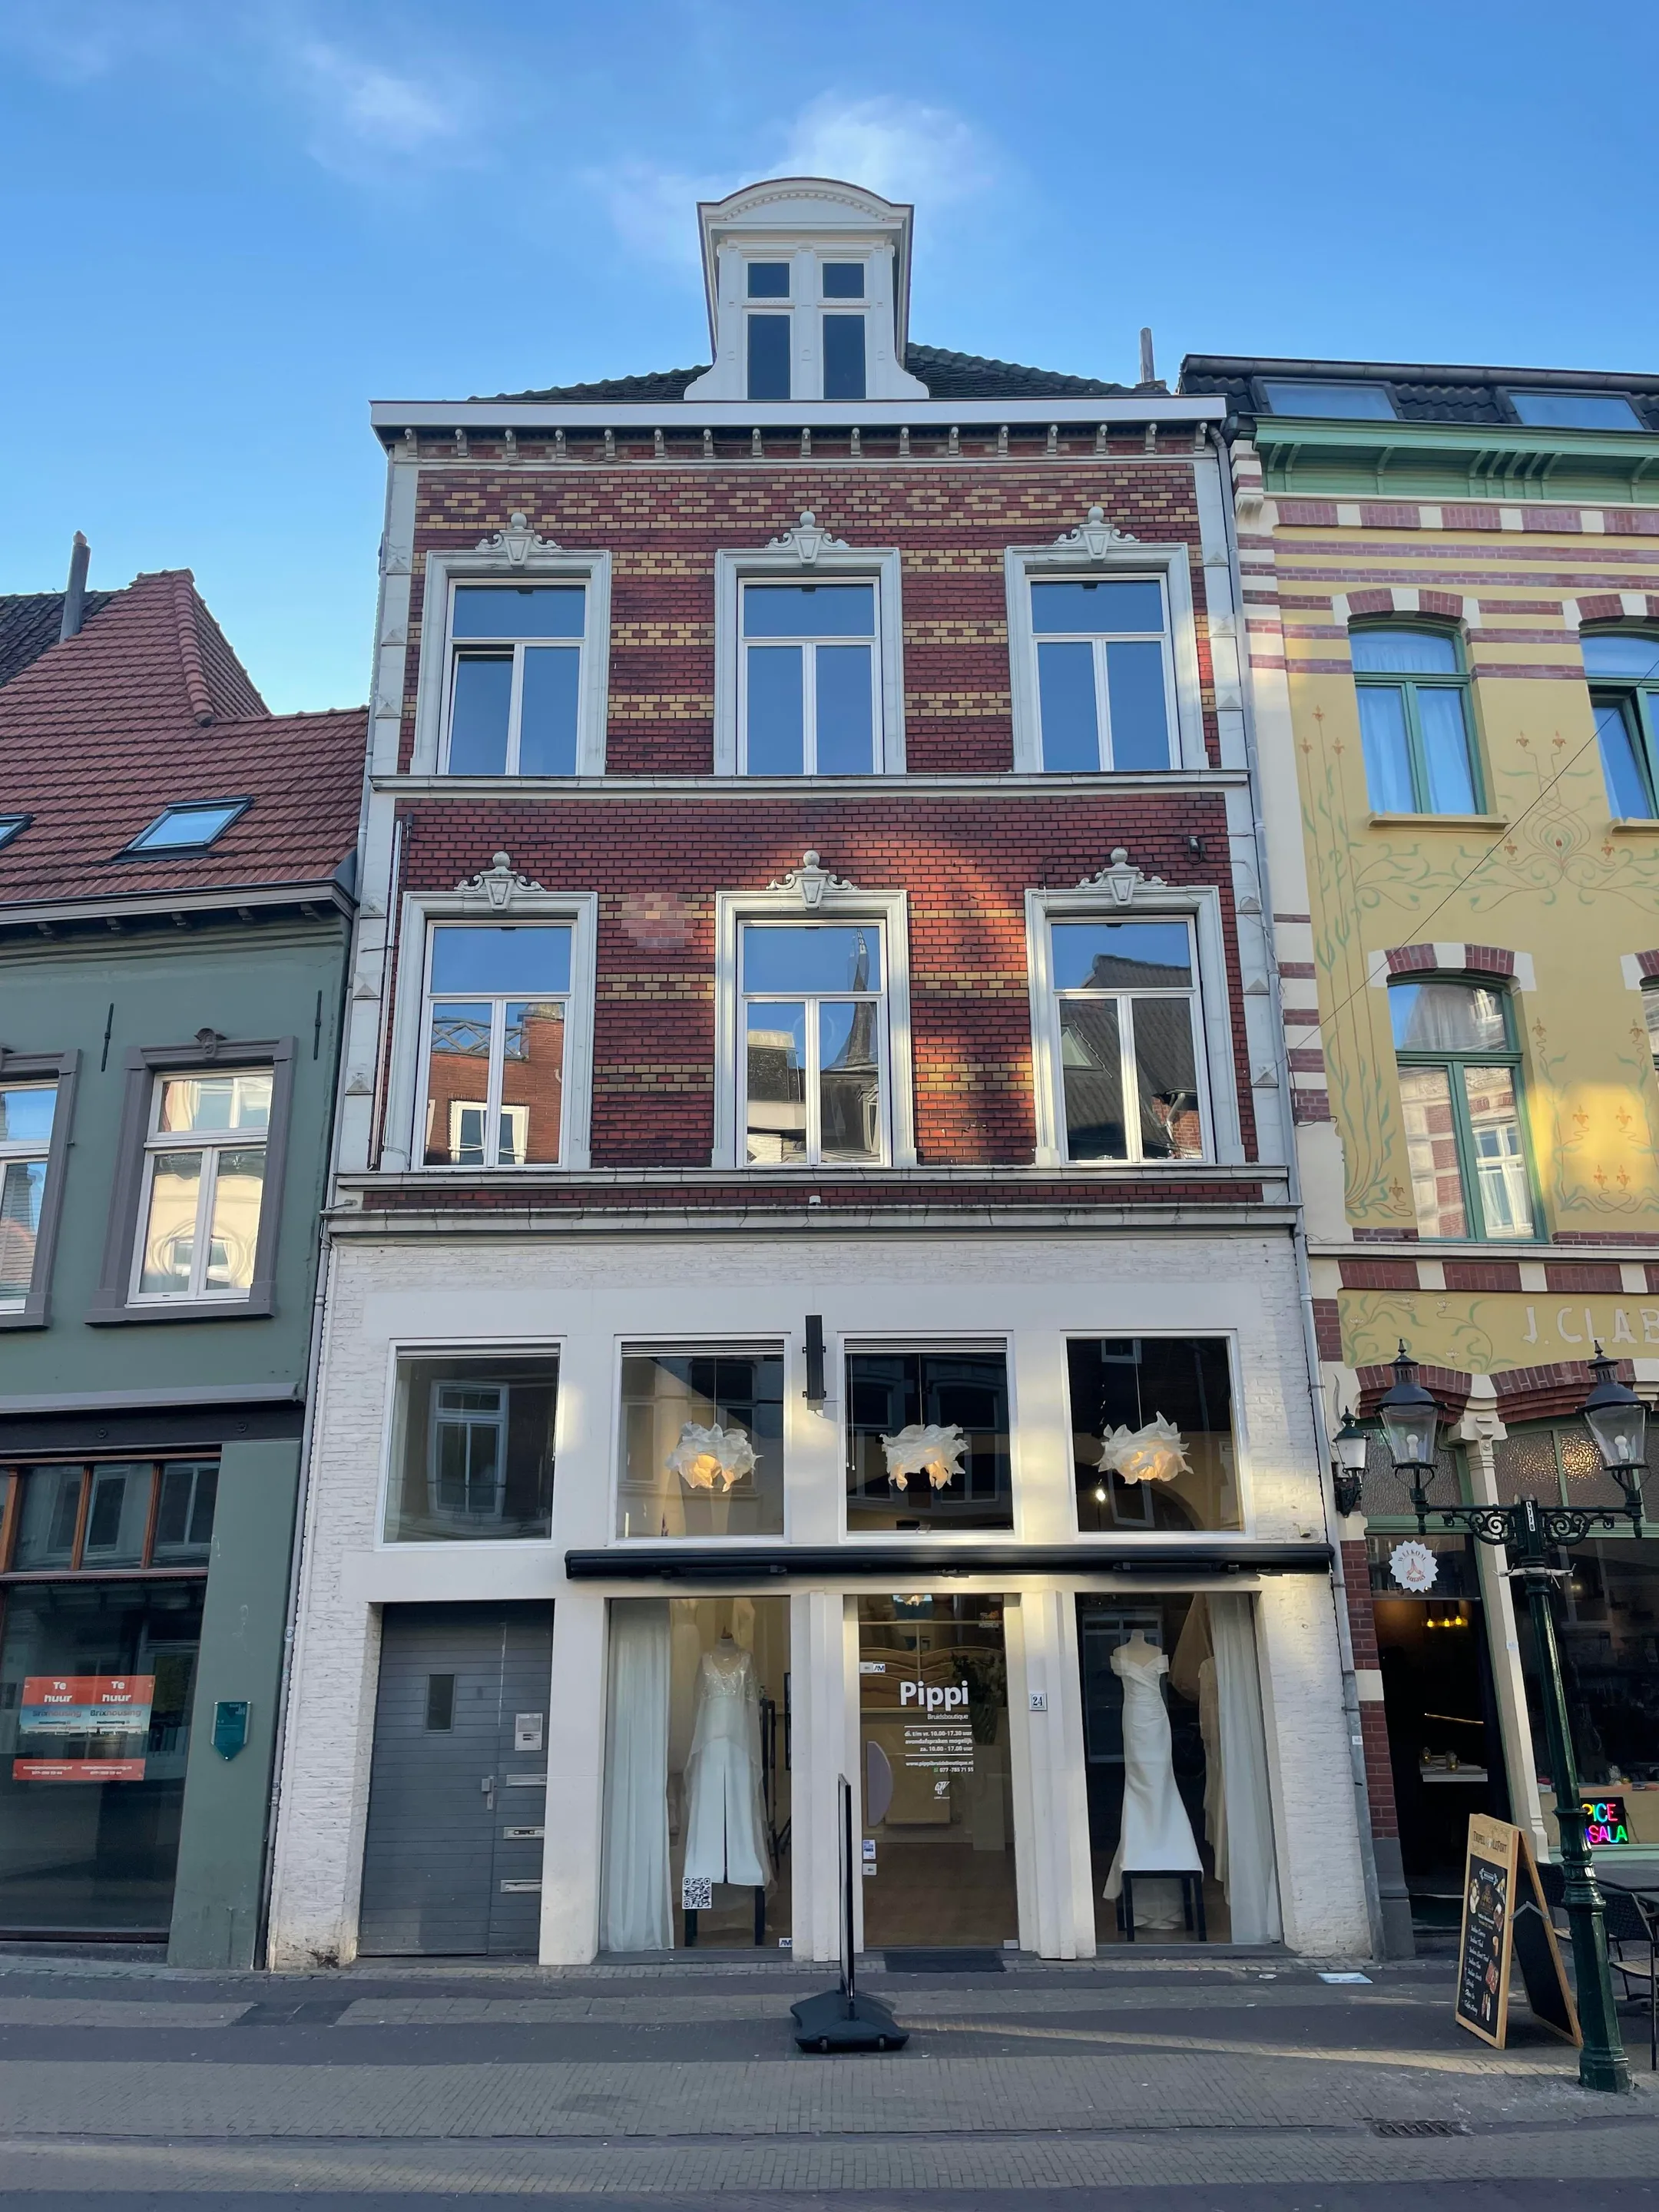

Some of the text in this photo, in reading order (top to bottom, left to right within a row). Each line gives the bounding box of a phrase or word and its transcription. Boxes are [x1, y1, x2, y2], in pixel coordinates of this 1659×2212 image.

[53, 1681, 67, 1690] Te
[111, 1681, 125, 1690] Te
[101, 1694, 131, 1702] huur
[900, 1681, 969, 1711] Pippi
[1032, 1696, 1043, 1706] 24
